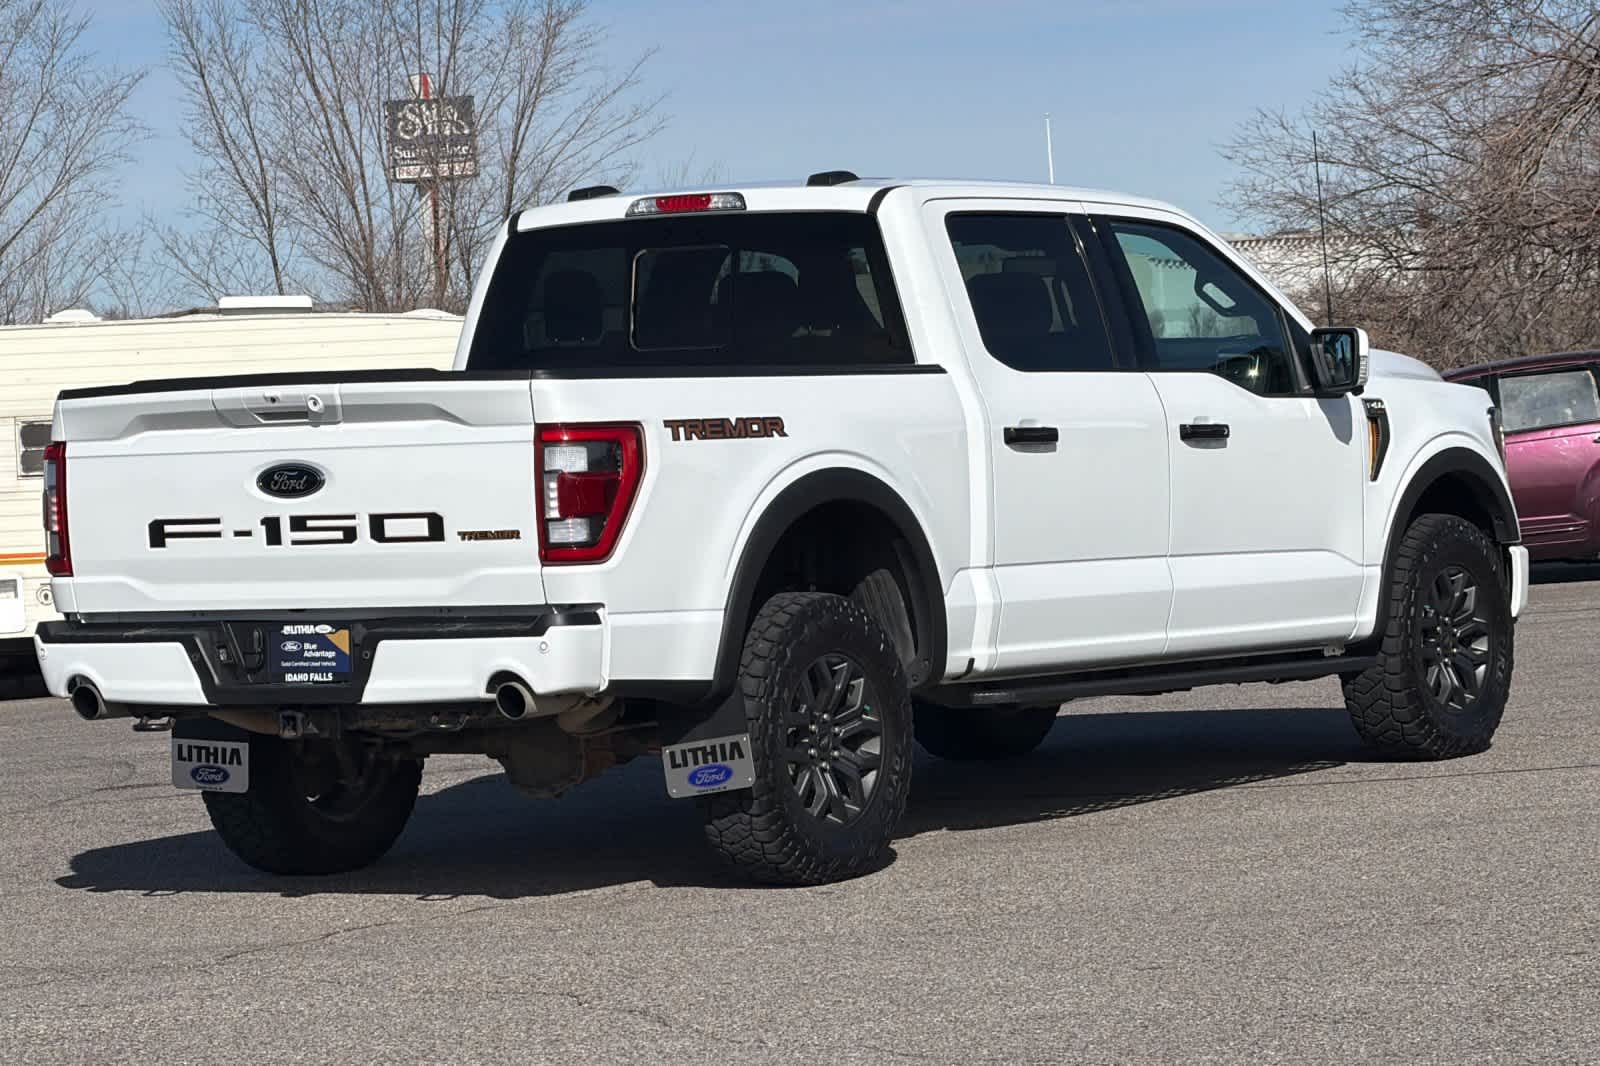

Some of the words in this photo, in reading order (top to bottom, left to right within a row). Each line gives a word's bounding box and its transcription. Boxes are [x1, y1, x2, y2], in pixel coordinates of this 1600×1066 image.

[662, 416, 789, 441] TREMOR
[270, 470, 307, 491] Ford
[148, 511, 446, 548] F-150
[457, 529, 521, 541] TREMOR
[303, 642, 318, 650] Blue
[303, 650, 336, 658] Advantage
[285, 672, 309, 682] IDAHO
[309, 672, 333, 681] FALLS
[177, 743, 242, 766] LITHIA
[669, 741, 745, 769] LITHIA
[196, 767, 224, 781] Ford
[695, 767, 726, 785] Ford
